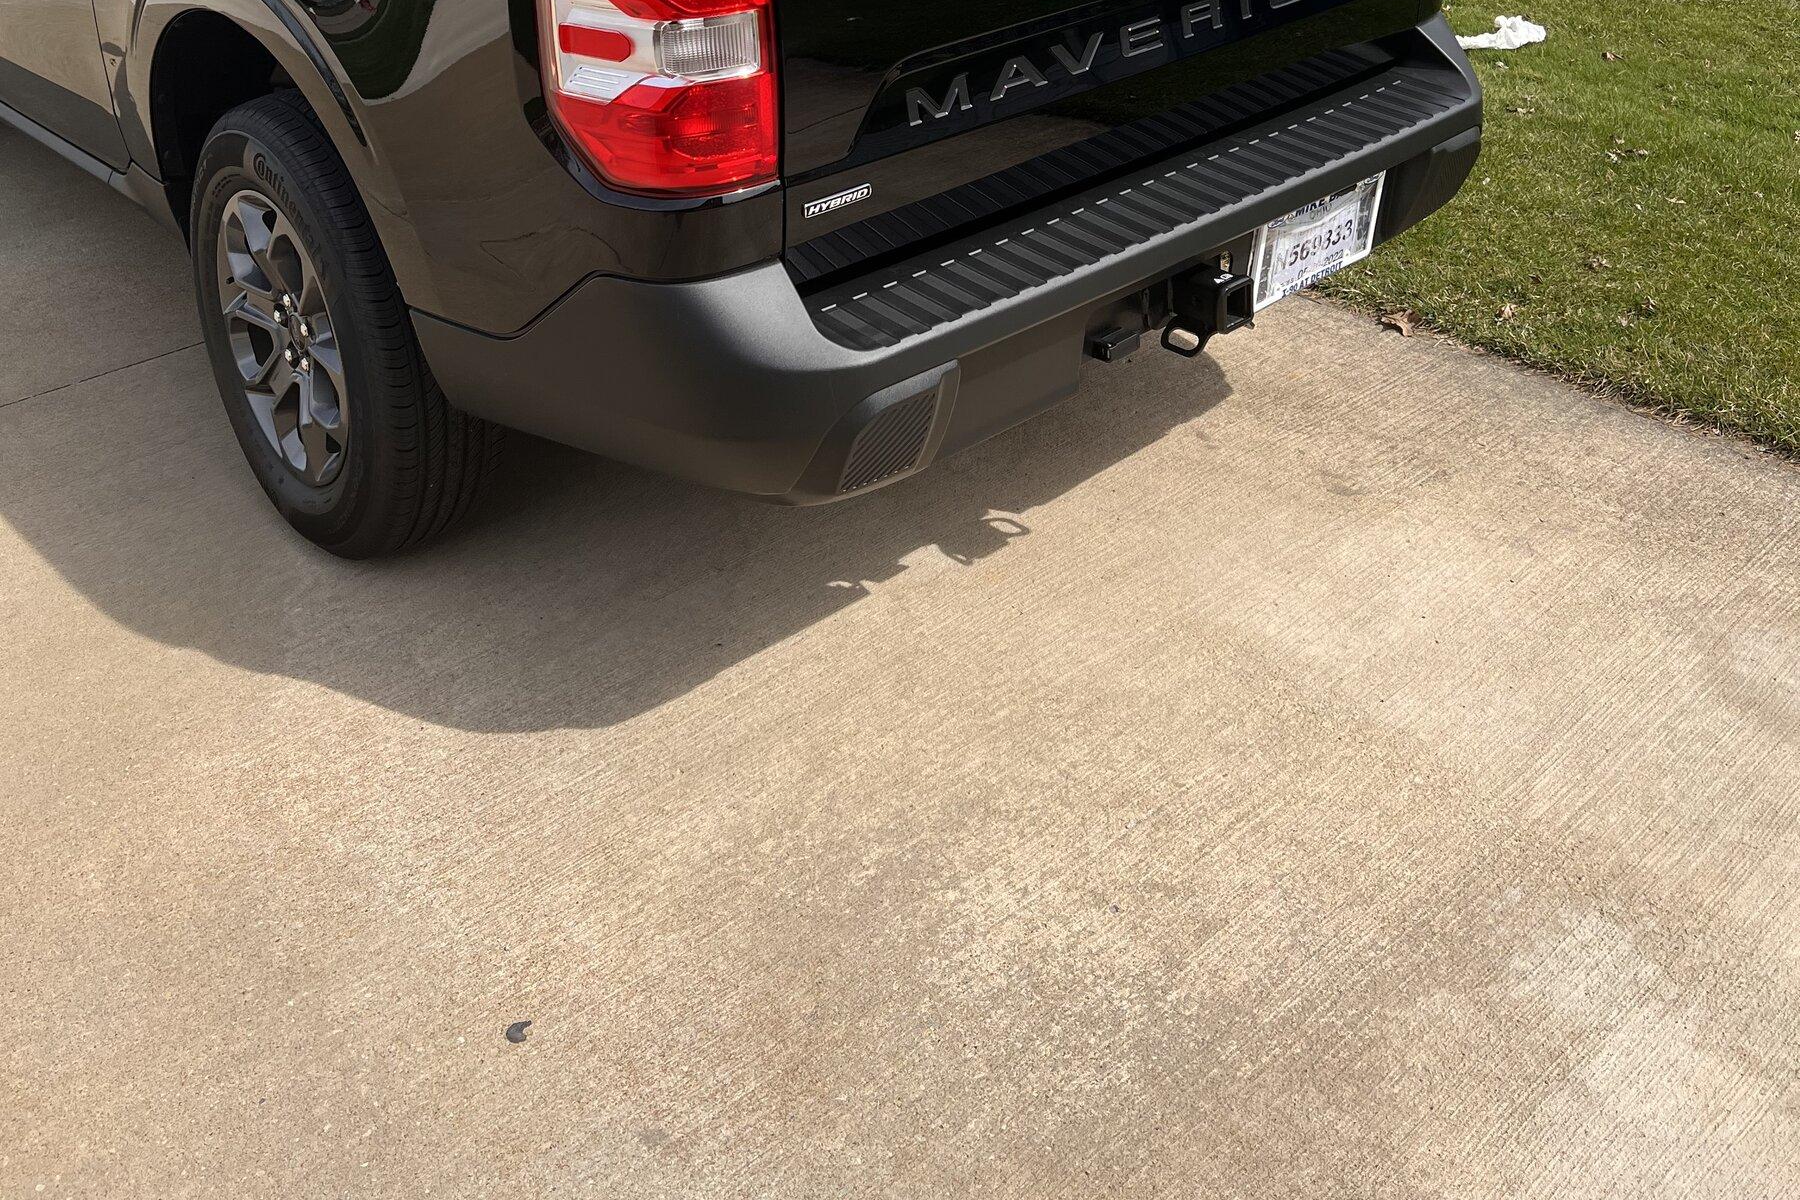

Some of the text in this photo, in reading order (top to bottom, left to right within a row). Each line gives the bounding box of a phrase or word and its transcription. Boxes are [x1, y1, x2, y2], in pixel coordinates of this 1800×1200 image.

[808, 187, 869, 216] HYBRID
[1299, 276, 1310, 289] AT
[1310, 261, 1344, 282] DETROIT
